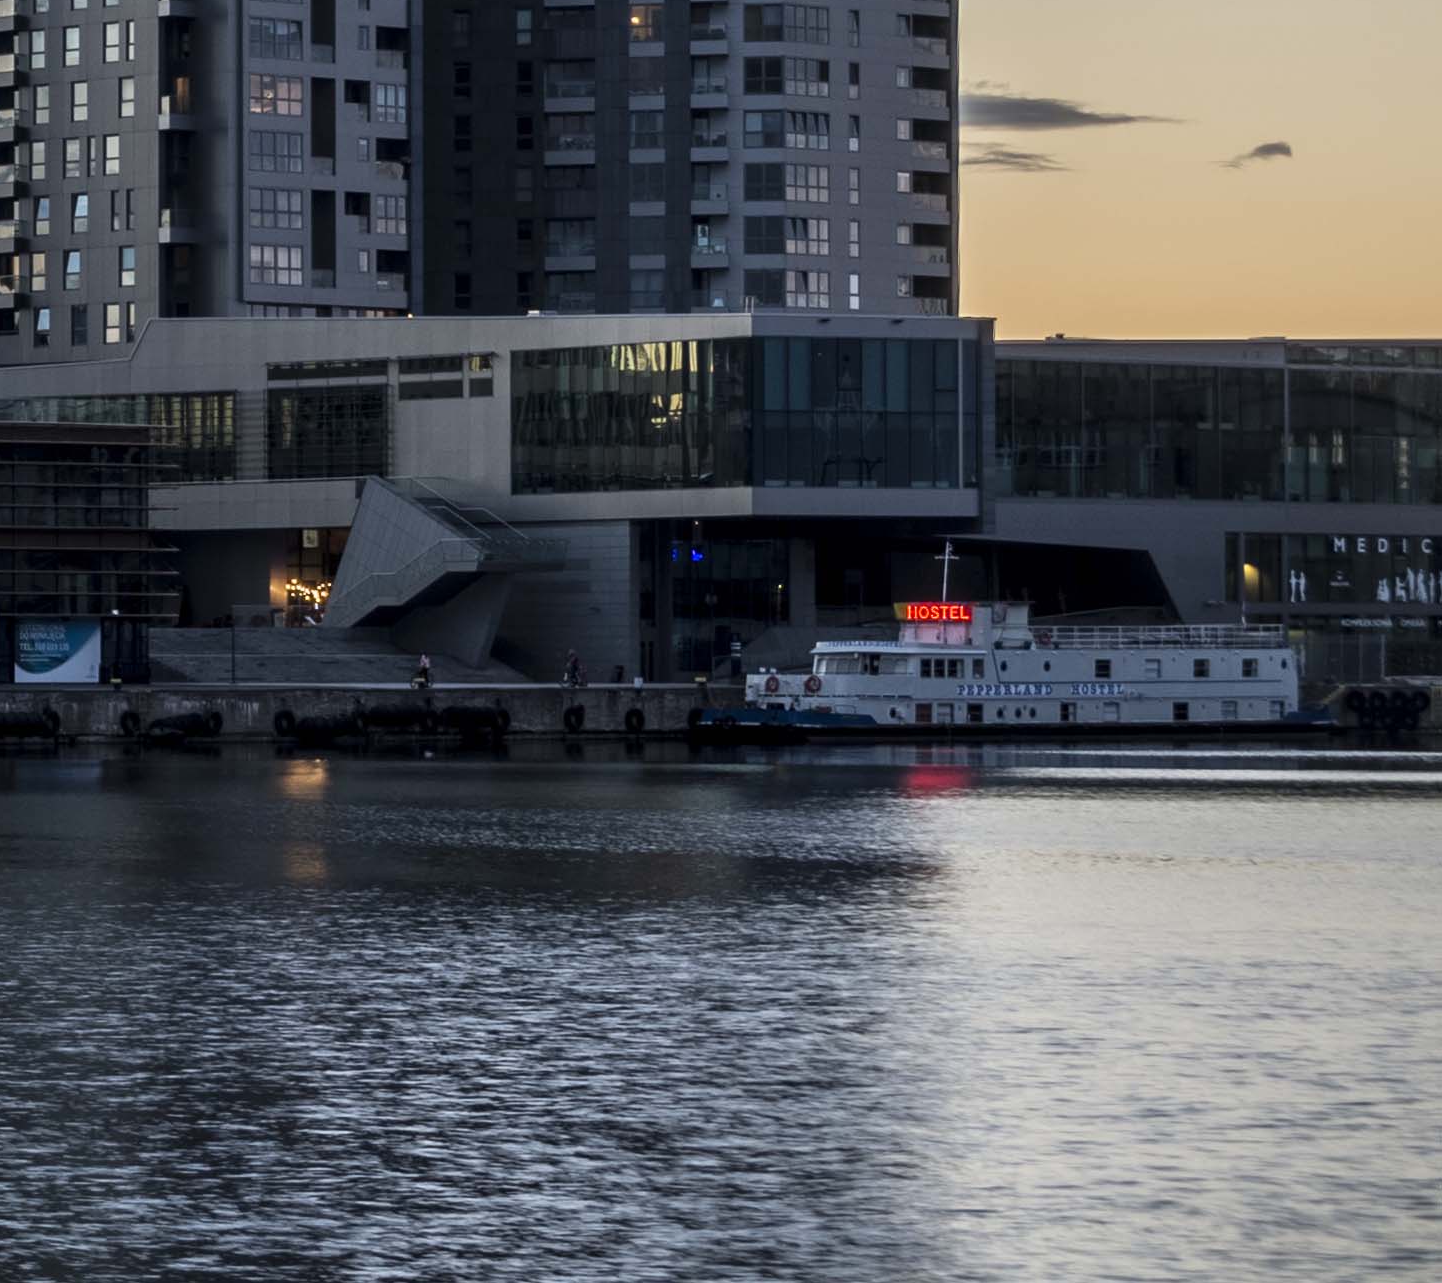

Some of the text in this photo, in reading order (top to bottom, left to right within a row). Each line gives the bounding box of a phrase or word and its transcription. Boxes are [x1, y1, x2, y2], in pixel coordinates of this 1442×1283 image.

[907, 605, 969, 619] HOSTEL
[957, 683, 1125, 697] PEPPERLAND HOSTEL
